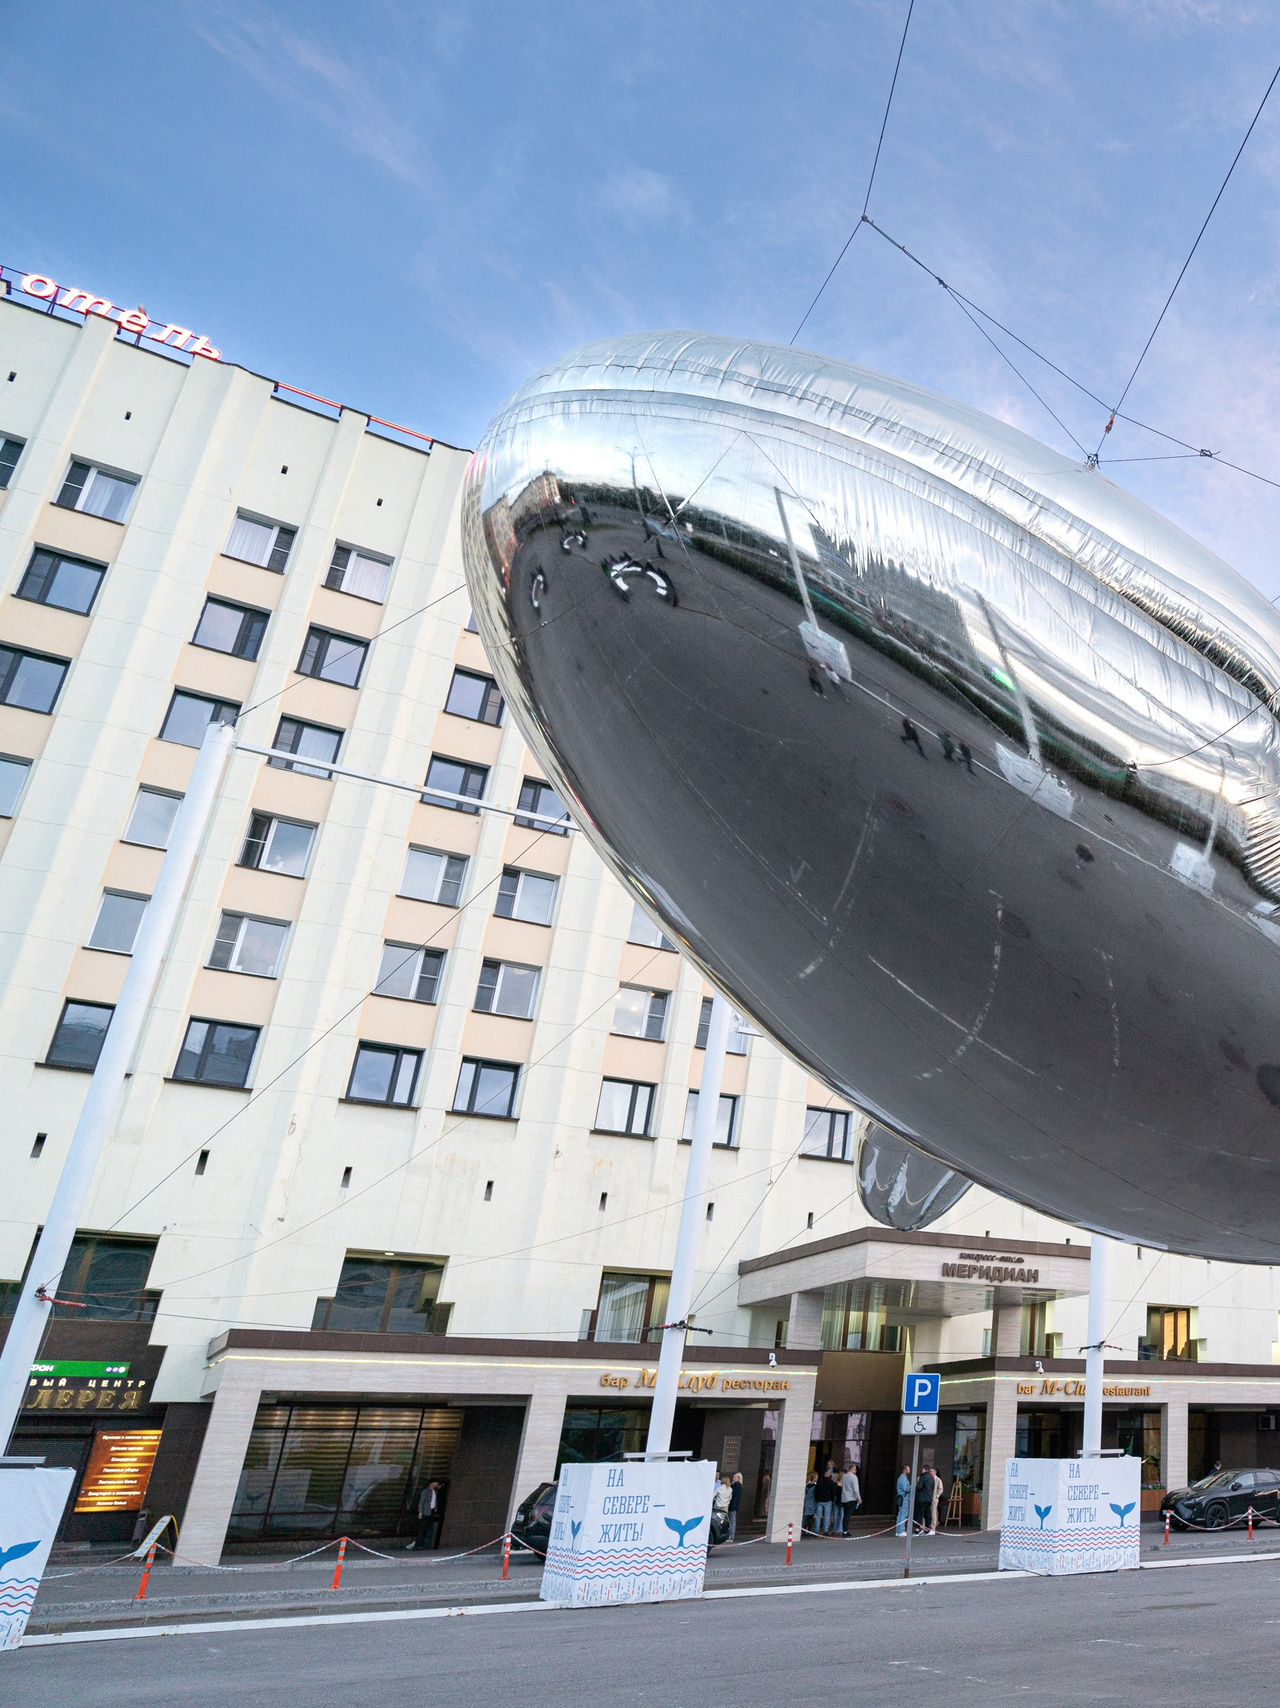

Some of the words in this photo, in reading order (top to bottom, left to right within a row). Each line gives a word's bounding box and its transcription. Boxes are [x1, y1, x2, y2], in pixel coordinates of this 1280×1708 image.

[22, 274, 222, 361] отель
[942, 1262, 1039, 1283] МЕРИДИАН
[88, 1379, 146, 1389] ЦЕНТР
[601, 1373, 630, 1391] бар
[722, 1378, 790, 1394] ресторан
[913, 1379, 932, 1407] P
[1017, 1382, 1036, 1395] bar
[1102, 1385, 1151, 1397] estaurant
[20, 1389, 143, 1410] ЛЕРЕЯ
[606, 1469, 625, 1487] НА
[1010, 1462, 1018, 1477] НА
[1069, 1463, 1081, 1478] НА
[1067, 1485, 1099, 1500] СЕВЕРЕ
[602, 1495, 650, 1515] СЕВЕРЕ
[1066, 1507, 1097, 1523] ЖИТЬ!
[598, 1522, 644, 1543] ЖИТЬ!
